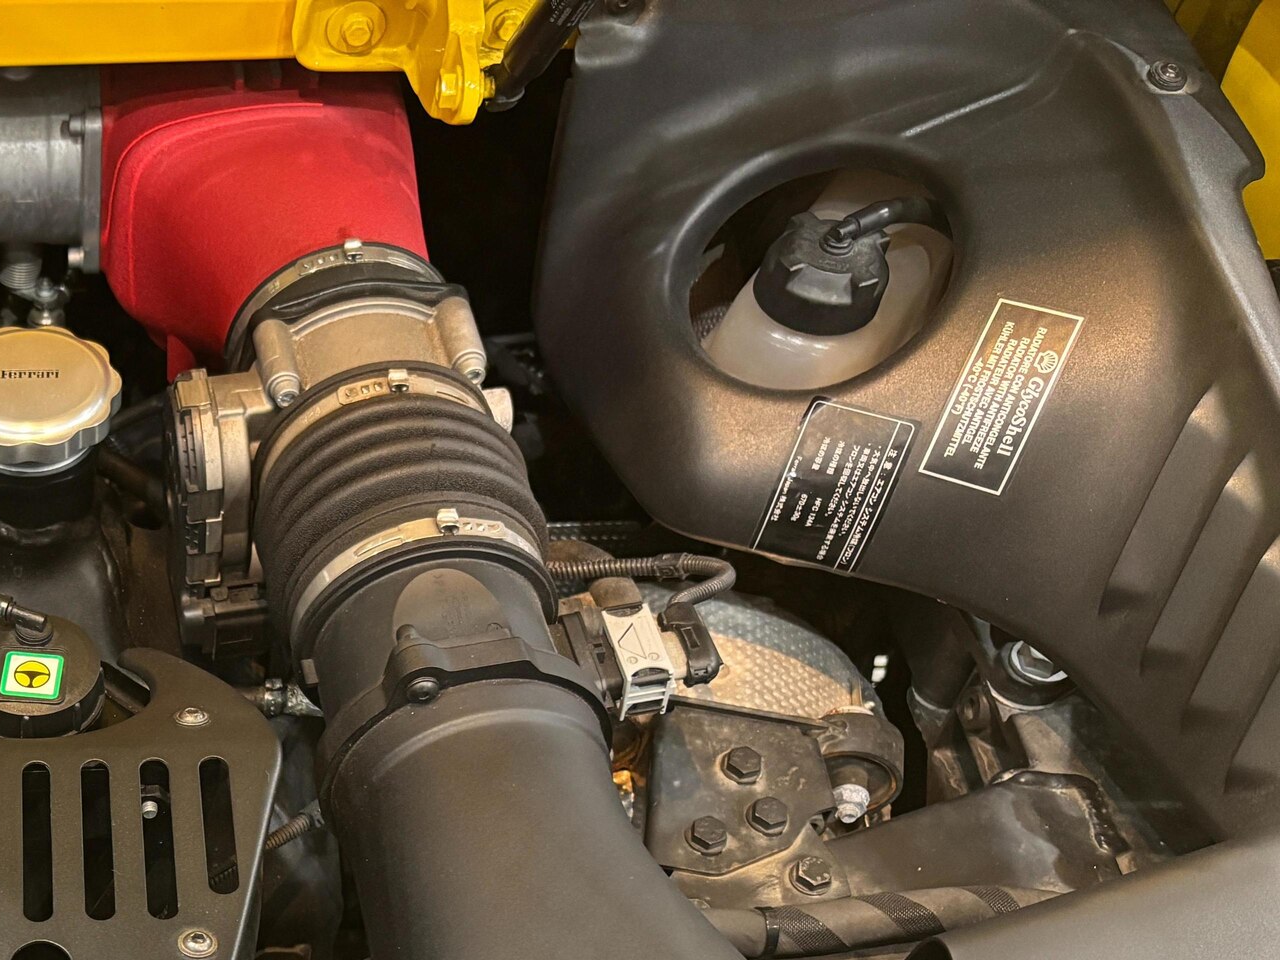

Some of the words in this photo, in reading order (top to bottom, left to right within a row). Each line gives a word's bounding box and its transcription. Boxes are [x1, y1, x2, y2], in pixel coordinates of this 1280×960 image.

[992, 321, 1015, 355] KÜHLER
[1018, 327, 1048, 374] RADIATORE
[1, 370, 60, 379] Ferrari
[985, 354, 999, 370] MIT
[989, 338, 1018, 386] RADIATEUR
[1004, 337, 1031, 380] RADIATOR
[978, 385, 996, 409] AVEC
[993, 380, 1011, 402] WITH
[1009, 374, 1025, 394] CON
[944, 369, 992, 457] FROSTSCHUTZMITTEL
[961, 408, 985, 445] ANTIGEL
[969, 401, 1000, 453] ANTIFREEZE
[997, 376, 1045, 456] GlycoShell
[974, 393, 1016, 469] ANTICONGELANTE
[805, 512, 816, 527] 134A
[811, 497, 822, 512] HFC
